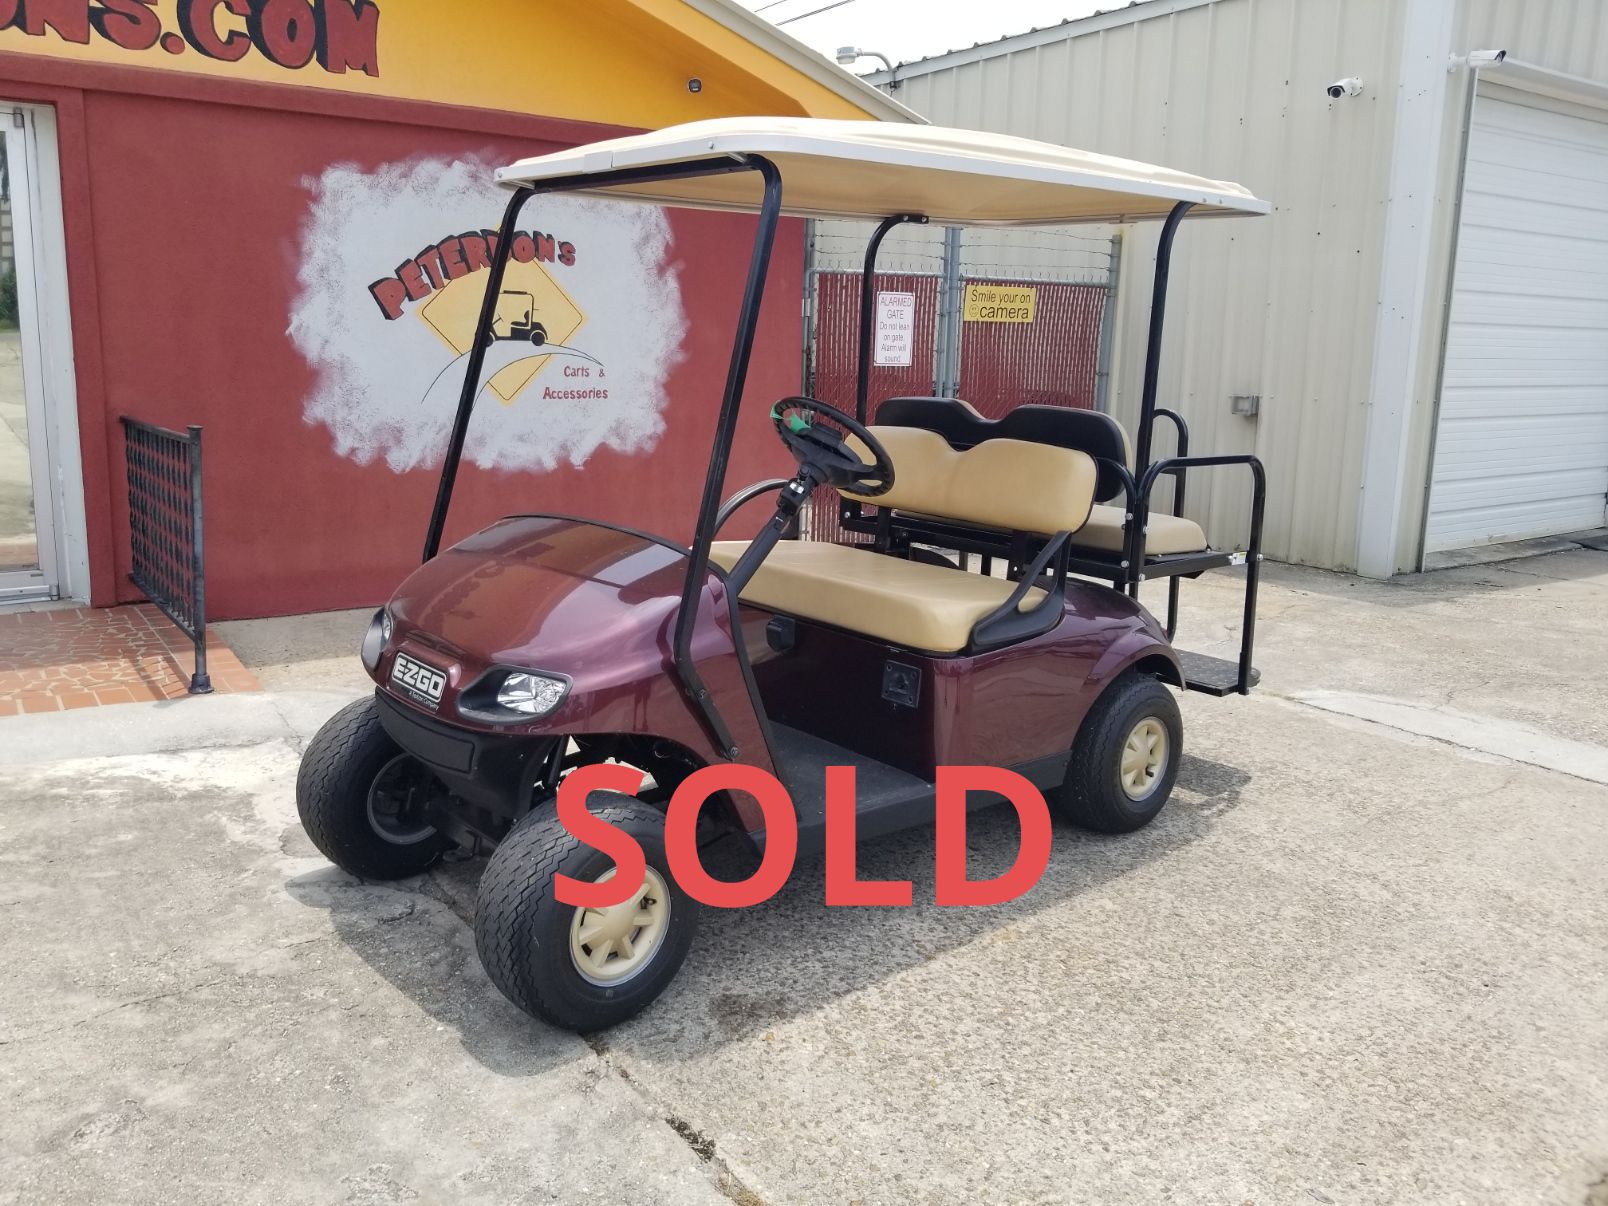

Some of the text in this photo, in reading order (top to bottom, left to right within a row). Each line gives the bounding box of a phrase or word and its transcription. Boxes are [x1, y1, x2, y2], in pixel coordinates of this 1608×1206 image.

[0, 0, 380, 78] NS.COM
[367, 228, 577, 321] PETERON'S
[880, 296, 912, 307] ALARMED
[971, 289, 1031, 306] Smile your on
[886, 309, 904, 319] GATE
[980, 306, 1029, 319] camera
[880, 321, 888, 330] Do
[889, 322, 898, 331] not
[891, 333, 904, 343] gate
[563, 365, 606, 378] Carts &
[542, 386, 609, 400] Accessories
